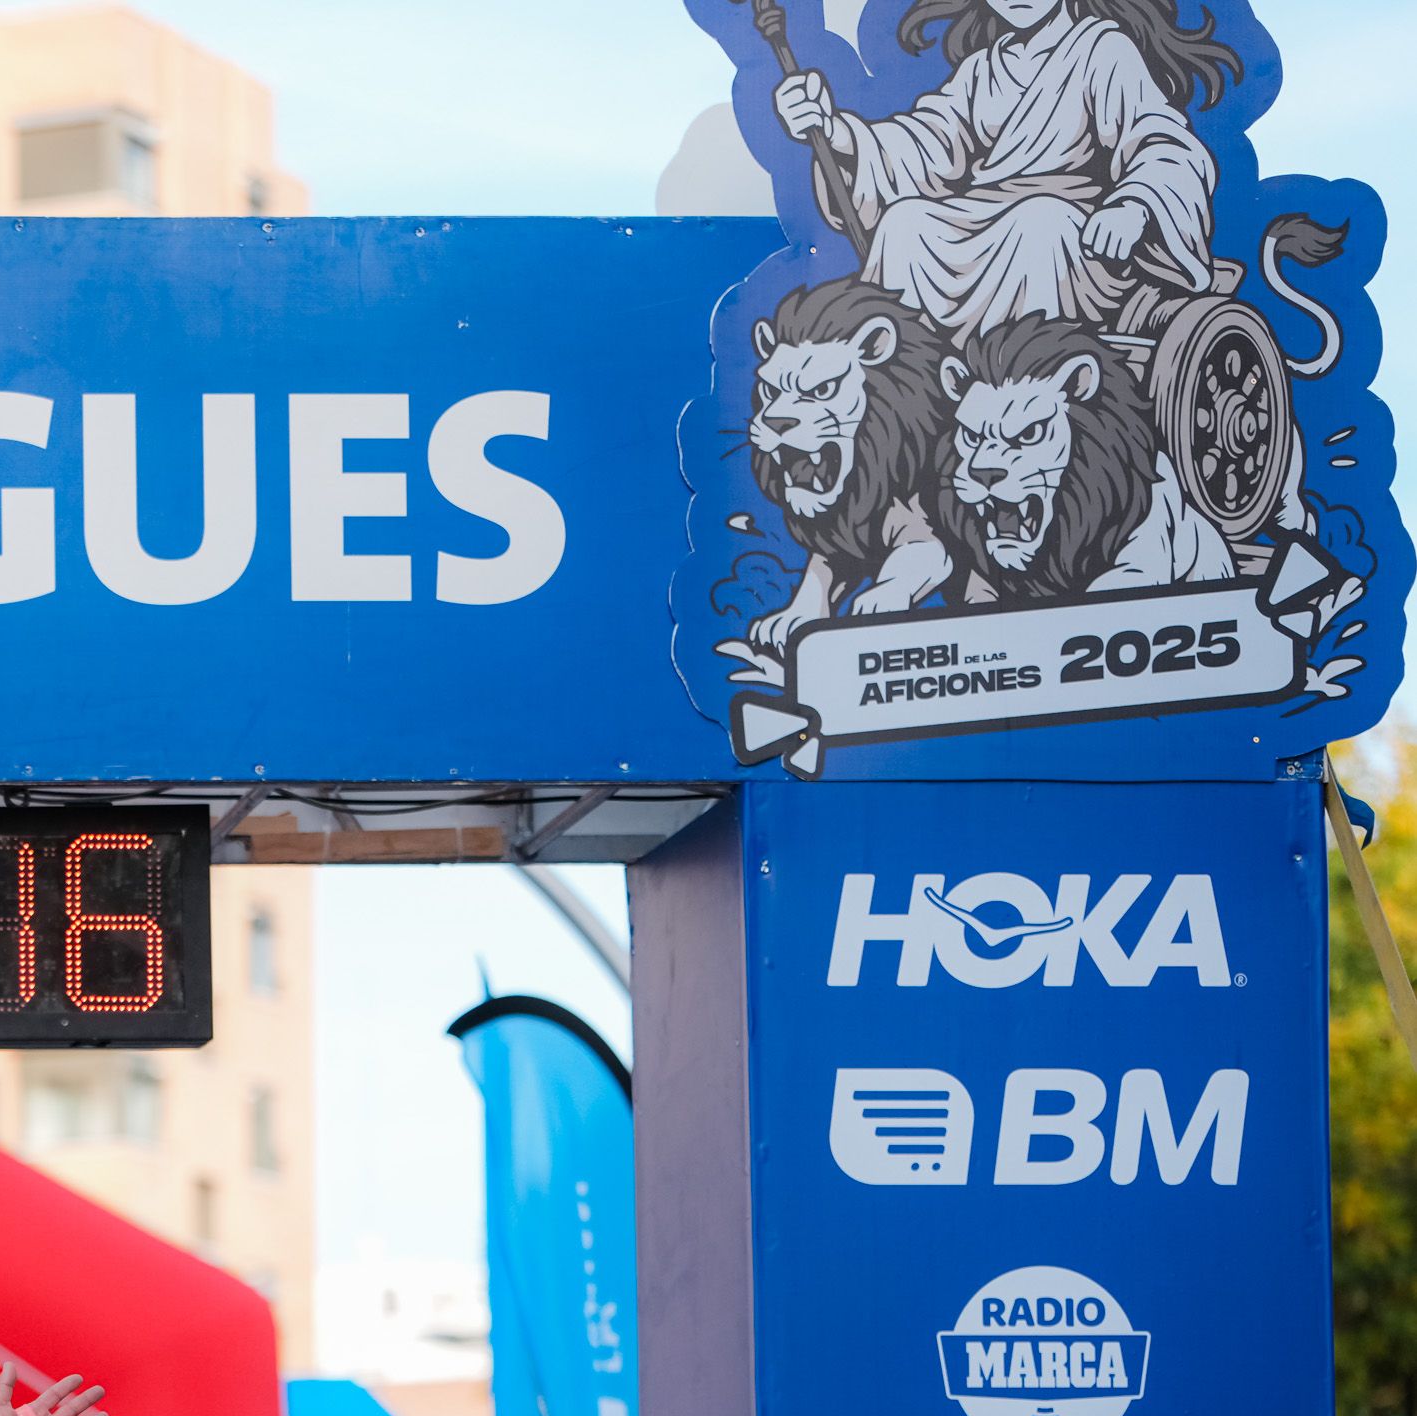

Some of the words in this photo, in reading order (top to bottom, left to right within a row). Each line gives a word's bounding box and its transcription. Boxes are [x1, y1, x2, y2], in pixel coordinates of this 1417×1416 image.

[858, 643, 959, 675] DERBI
[964, 656, 980, 664] DE
[983, 652, 1007, 663] LAS
[1060, 619, 1241, 684] 2025
[859, 665, 1042, 706] AFICIONES
[827, 872, 1233, 989] HOKA
[994, 1069, 1249, 1185] BM
[981, 1297, 1106, 1328] RADIO
[965, 1341, 1128, 1390] MARCA
